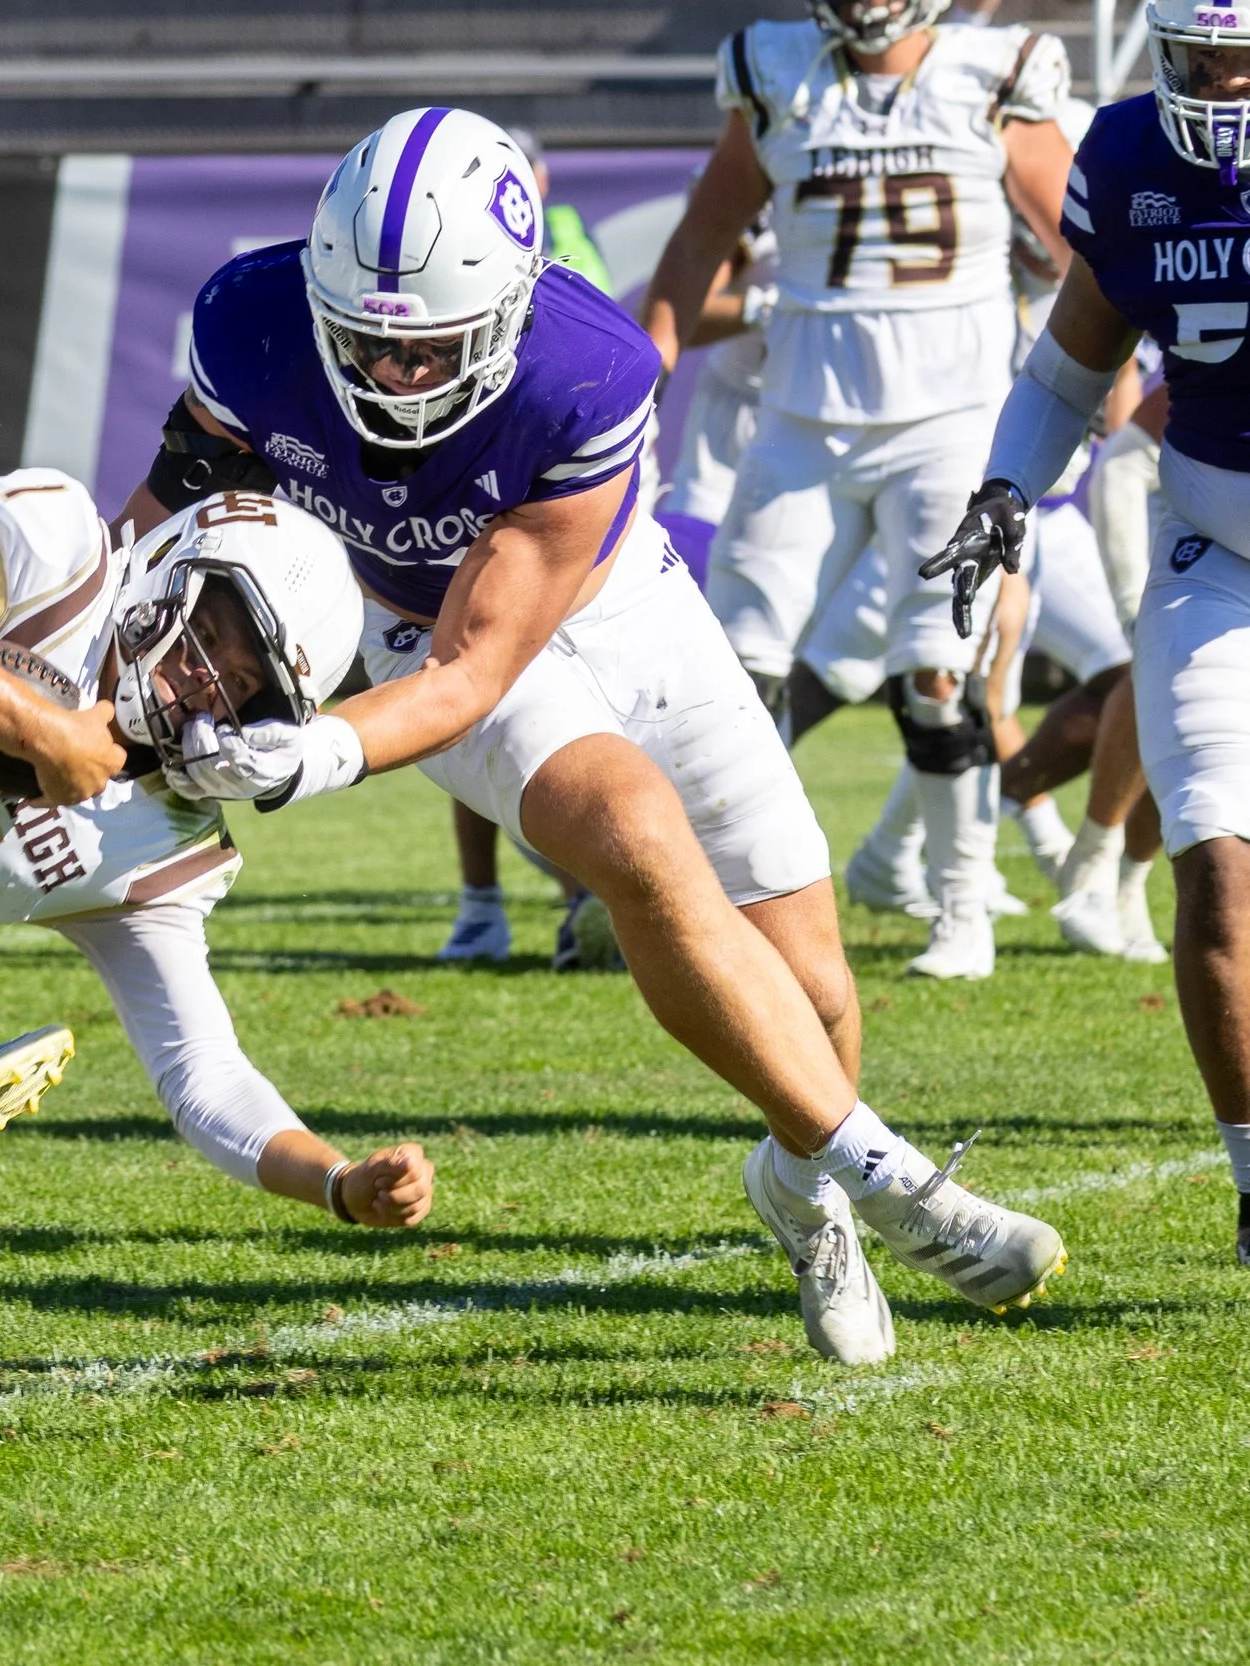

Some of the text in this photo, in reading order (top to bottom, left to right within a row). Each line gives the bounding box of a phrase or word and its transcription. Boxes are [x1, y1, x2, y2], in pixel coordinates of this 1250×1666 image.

[1197, 12, 1237, 28] 508
[793, 172, 958, 290] 79
[1129, 206, 1180, 221] PATRIOT
[1130, 216, 1181, 227] LEAGUE
[1154, 237, 1234, 282] HOLY
[1168, 302, 1248, 364] 5
[393, 404, 420, 415] Riddel
[288, 478, 375, 545] HOLY
[6, 798, 86, 895] IGH
